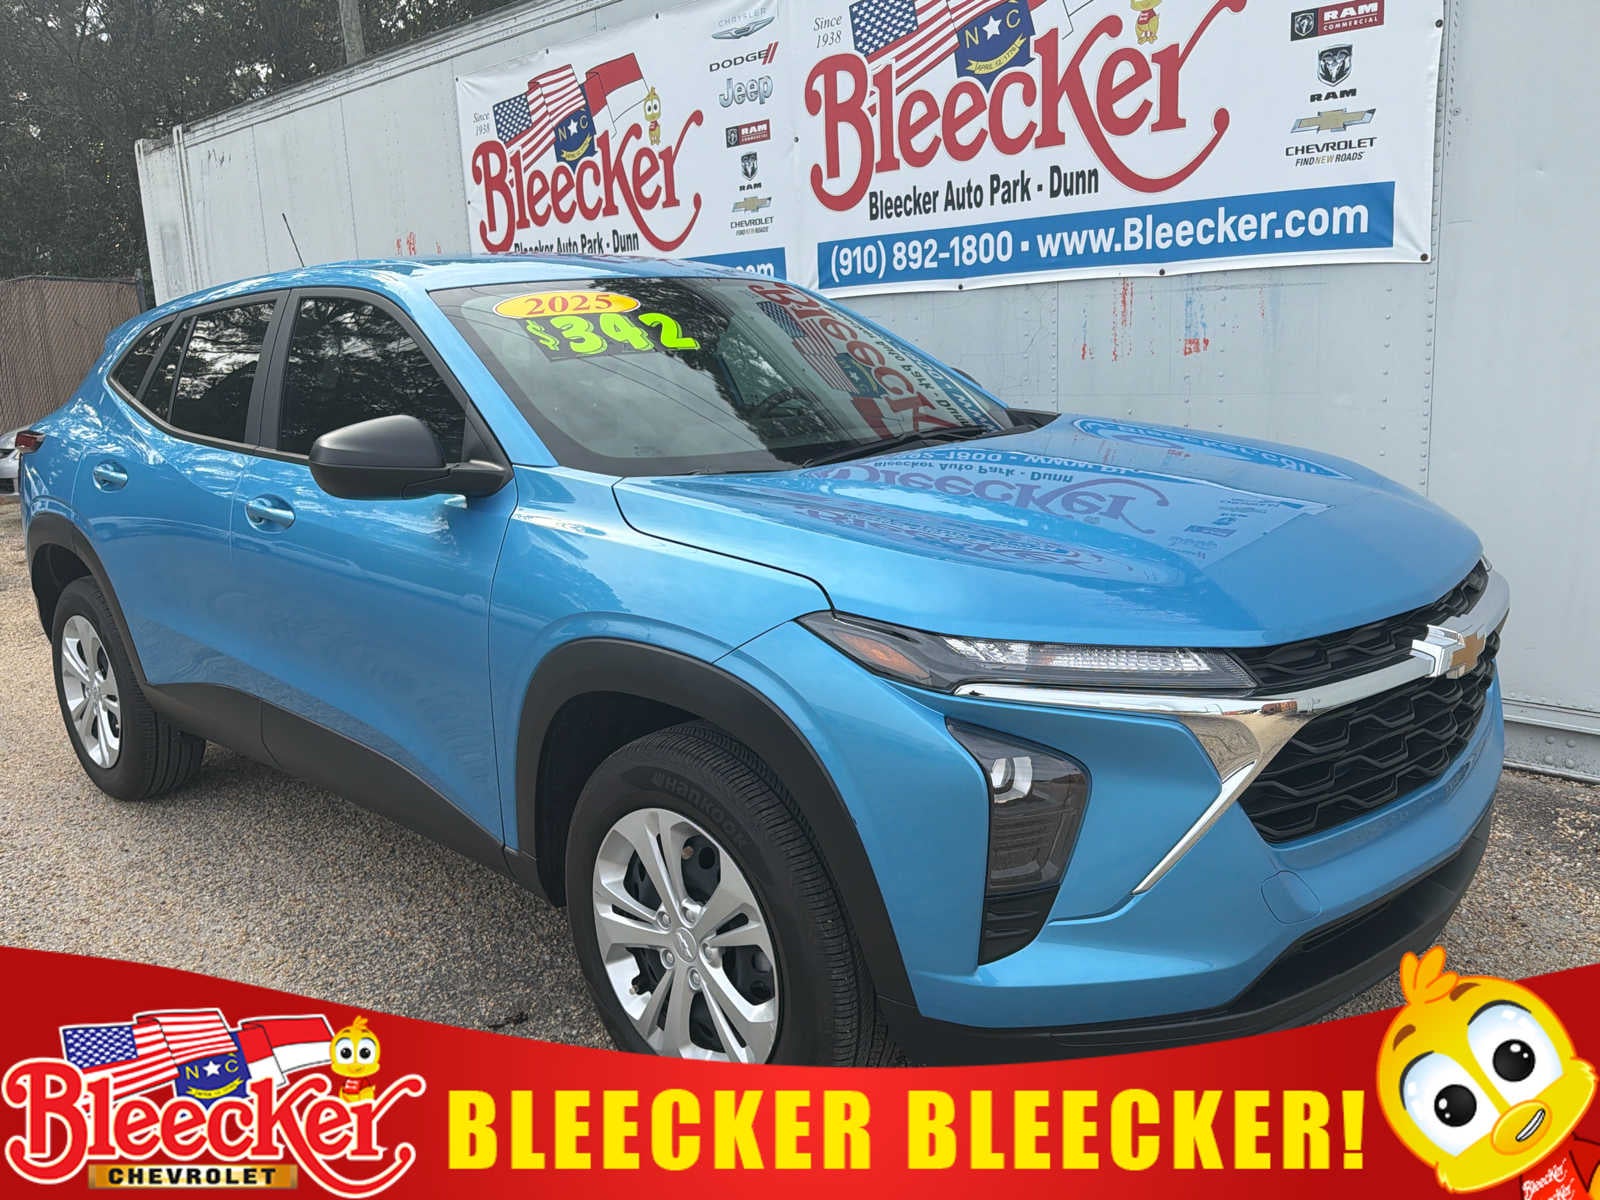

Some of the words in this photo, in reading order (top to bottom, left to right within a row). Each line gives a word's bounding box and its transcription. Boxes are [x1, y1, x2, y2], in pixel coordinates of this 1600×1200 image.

[813, 13, 842, 32] Since
[1323, 2, 1379, 22] RAM
[965, 26, 979, 49] N
[1006, 9, 1021, 29] C
[1323, 17, 1378, 31] COMMERCIAL
[815, 30, 842, 49] 1938
[709, 48, 770, 72] DODGE
[719, 75, 773, 108] Jeep
[1310, 88, 1358, 103] RAM
[804, 0, 1247, 212] Bleecker
[741, 123, 768, 136] RAM
[1285, 136, 1378, 157] CHEVROLET
[471, 109, 704, 254] Bleecker
[739, 182, 762, 192] RAM
[868, 185, 940, 221] Bleecker
[943, 178, 984, 212] Auto
[989, 169, 1032, 207] Park
[1049, 164, 1100, 199] Dunn
[580, 232, 604, 254] Park
[612, 229, 640, 253] Dunn
[830, 239, 887, 283] (910)
[891, 230, 1014, 272] 892-1800
[1036, 203, 1369, 258] www.Bleecker.com
[525, 294, 613, 316] 2025
[525, 312, 701, 356] $342
